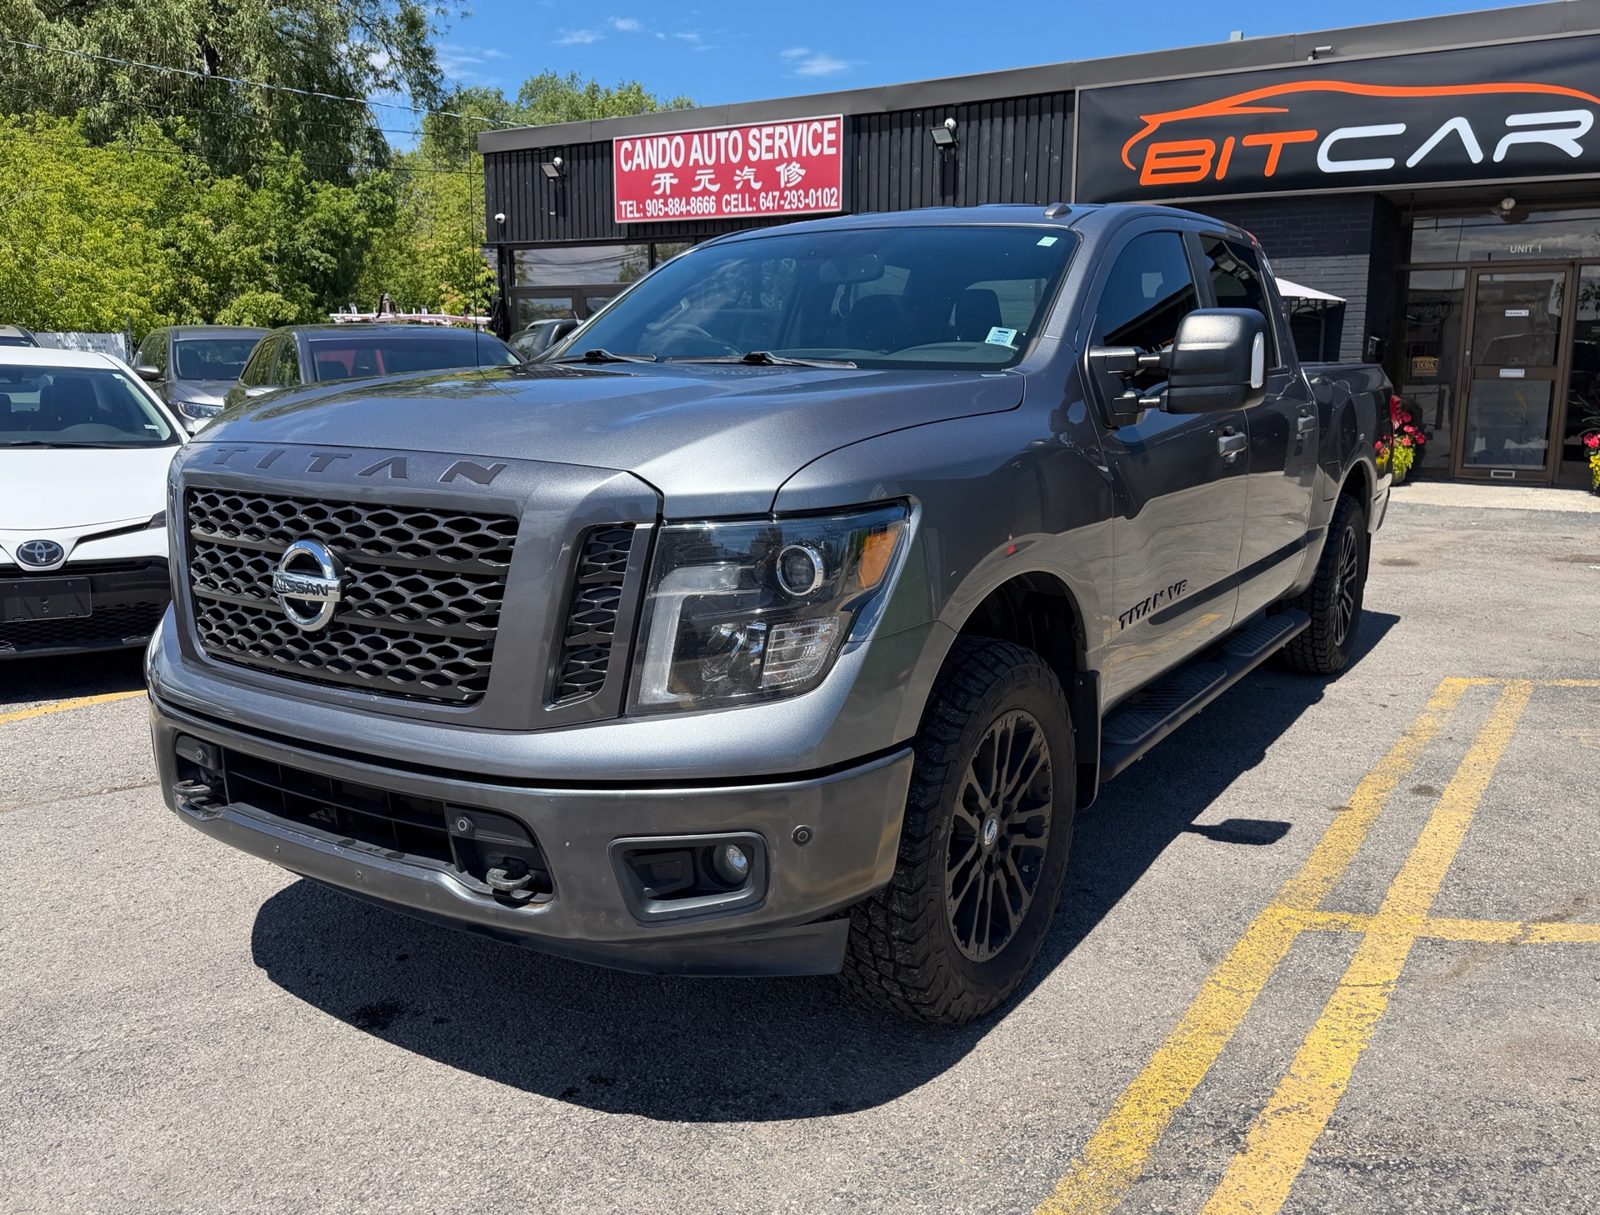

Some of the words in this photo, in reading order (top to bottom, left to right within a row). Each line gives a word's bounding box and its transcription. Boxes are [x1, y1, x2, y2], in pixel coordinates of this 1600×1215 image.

[620, 136, 685, 172] CANDO
[689, 130, 742, 166] AUTO
[748, 120, 837, 161] SERVICE
[1140, 109, 1595, 185] BITCAR
[651, 161, 806, 195] 开元汽修
[620, 200, 643, 218] TEL:
[645, 195, 716, 217] 905-884-8666
[722, 193, 756, 213] CELL:
[760, 187, 838, 211] 647-293-0102
[1510, 244, 1534, 253] UNIT
[1536, 244, 1542, 253] 1
[213, 447, 507, 484] TITAN
[275, 577, 329, 596] NISSAN
[1119, 590, 1164, 630] TITAN
